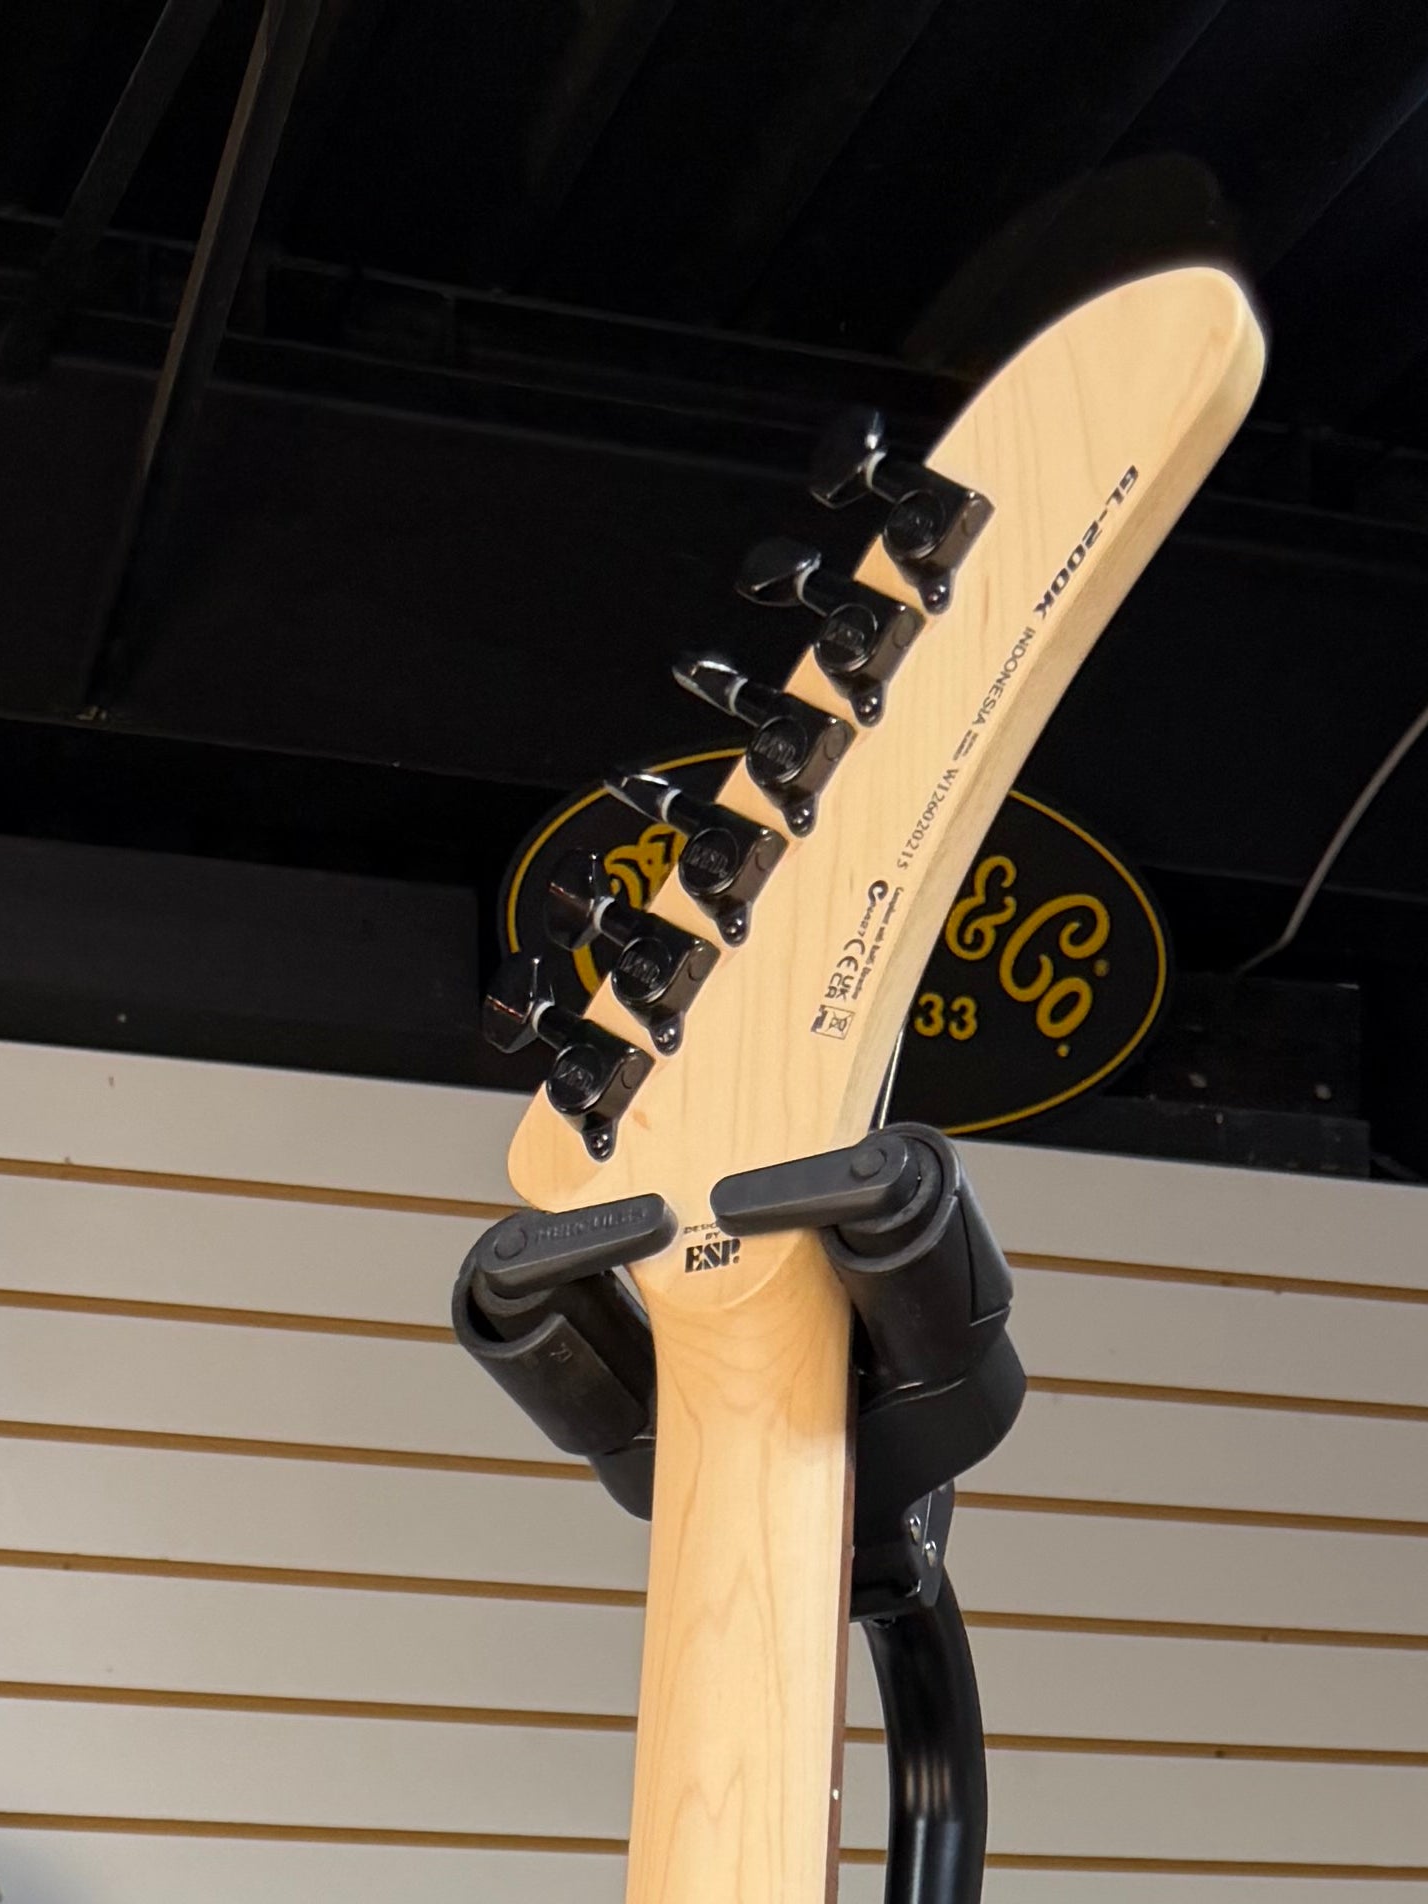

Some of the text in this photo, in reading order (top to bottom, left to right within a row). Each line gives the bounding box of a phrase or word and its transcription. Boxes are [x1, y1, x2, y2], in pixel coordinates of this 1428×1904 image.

[1035, 467, 1138, 616] GL-200K
[973, 627, 1035, 724] INDONESIA
[945, 855, 1017, 961] &
[914, 992, 978, 1041] 33
